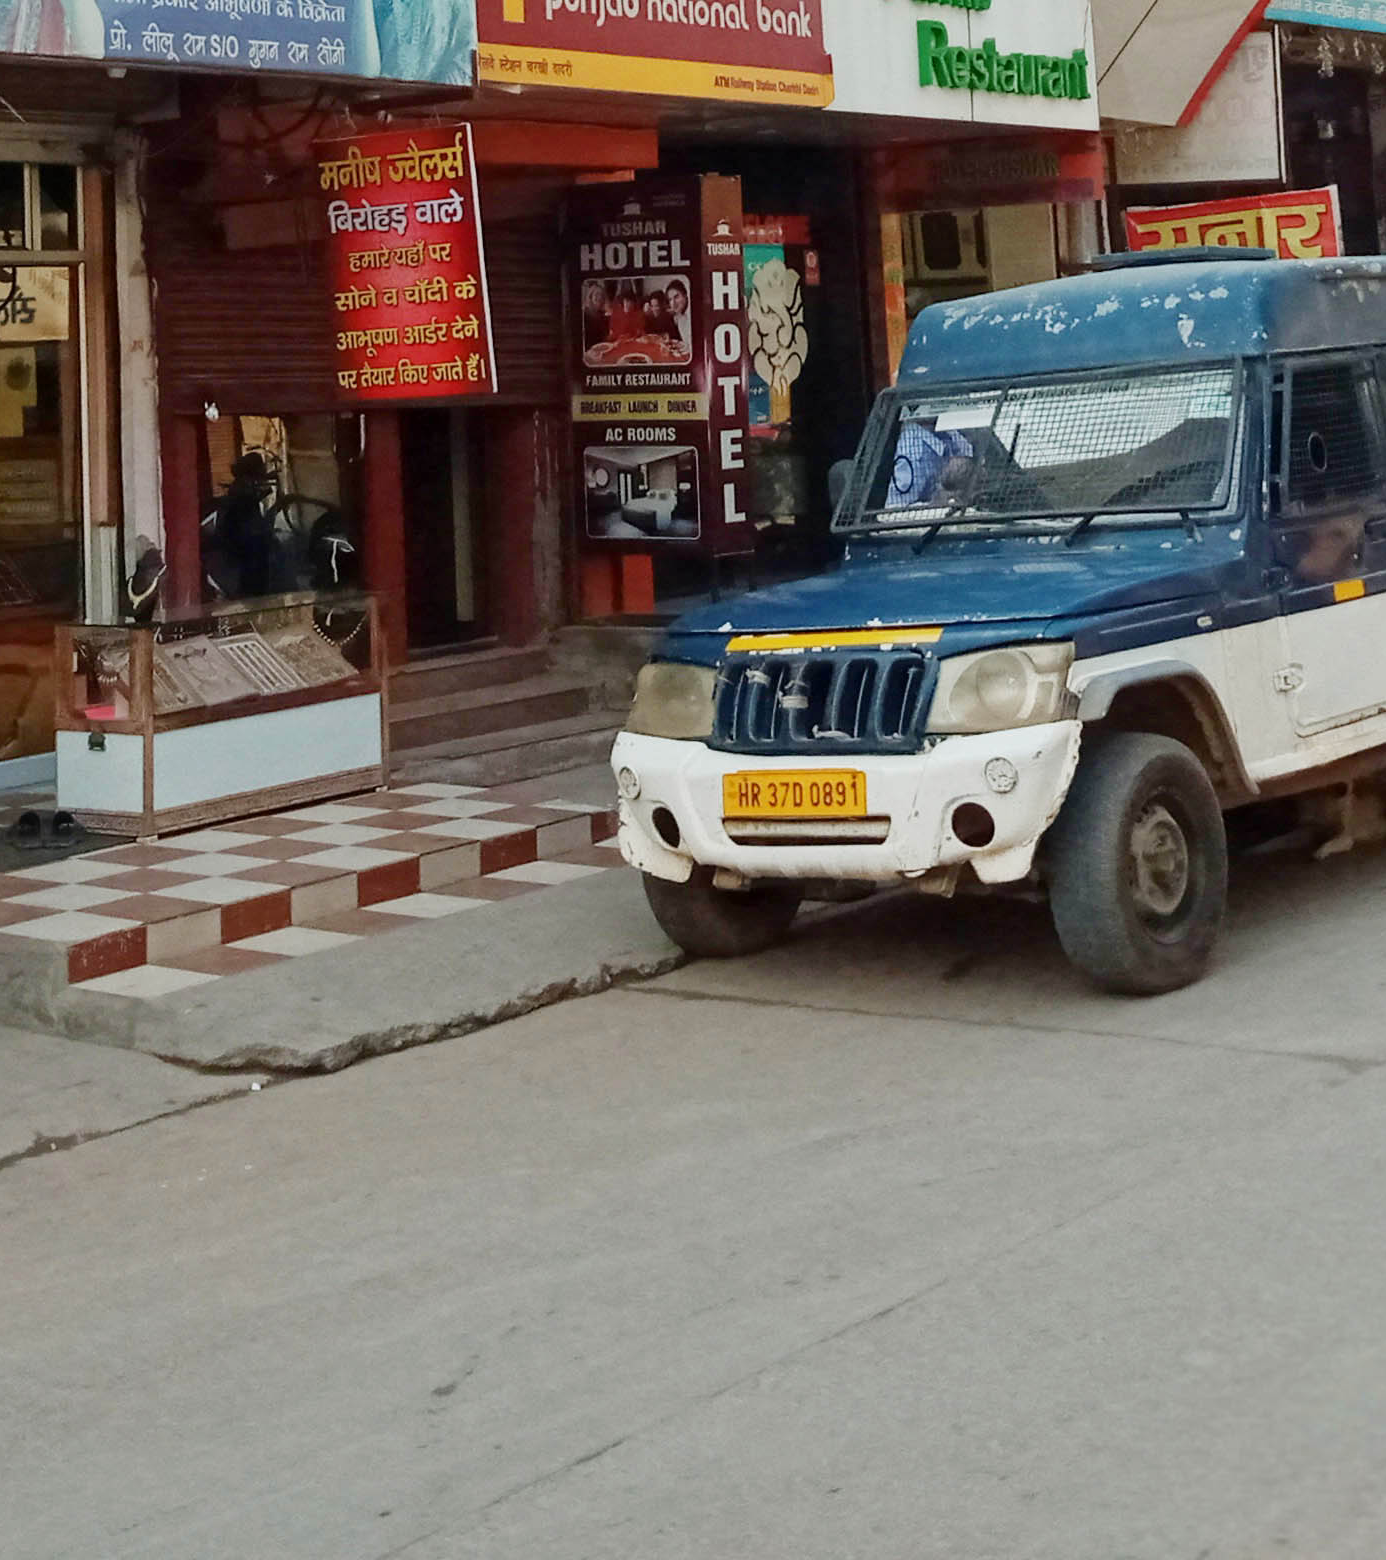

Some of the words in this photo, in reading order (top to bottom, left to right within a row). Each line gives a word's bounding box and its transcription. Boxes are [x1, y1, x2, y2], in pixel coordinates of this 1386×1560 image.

[755, 3, 812, 40] bank
[109, 20, 132, 51] प्रो.
[183, 32, 207, 56] राम
[210, 35, 239, 59] S/O
[287, 42, 309, 64] राम
[317, 38, 345, 65] सोनी
[916, 19, 1091, 101] Restaurant
[714, 75, 730, 89] ATM
[318, 148, 381, 191] मनीष
[386, 132, 465, 184] ज्वैलर्स
[414, 187, 464, 224] वाले
[601, 220, 667, 238] TUSHAR
[348, 244, 391, 273] हमारे
[429, 243, 451, 264] पर
[580, 240, 691, 272] HOTEL
[707, 243, 741, 257] TUSHAR
[335, 284, 377, 312] सोने
[382, 288, 398, 307] व
[453, 274, 477, 300] के
[336, 327, 398, 358] आभूषण
[403, 316, 448, 345] आर्डर
[451, 314, 479, 340] देने
[337, 370, 358, 390] पर
[360, 361, 395, 388] तैयार
[399, 358, 428, 385] किए
[430, 355, 463, 382] जाते
[586, 373, 622, 387] FAMILY
[625, 372, 692, 387] RESTAURANT
[667, 399, 698, 415] DINNER
[712, 271, 747, 525] HOTEL
[605, 428, 623, 443] AC
[627, 426, 677, 442] ROOMS
[738, 781, 761, 808] HR
[768, 780, 803, 808] 37D
[810, 773, 860, 807] 0891
